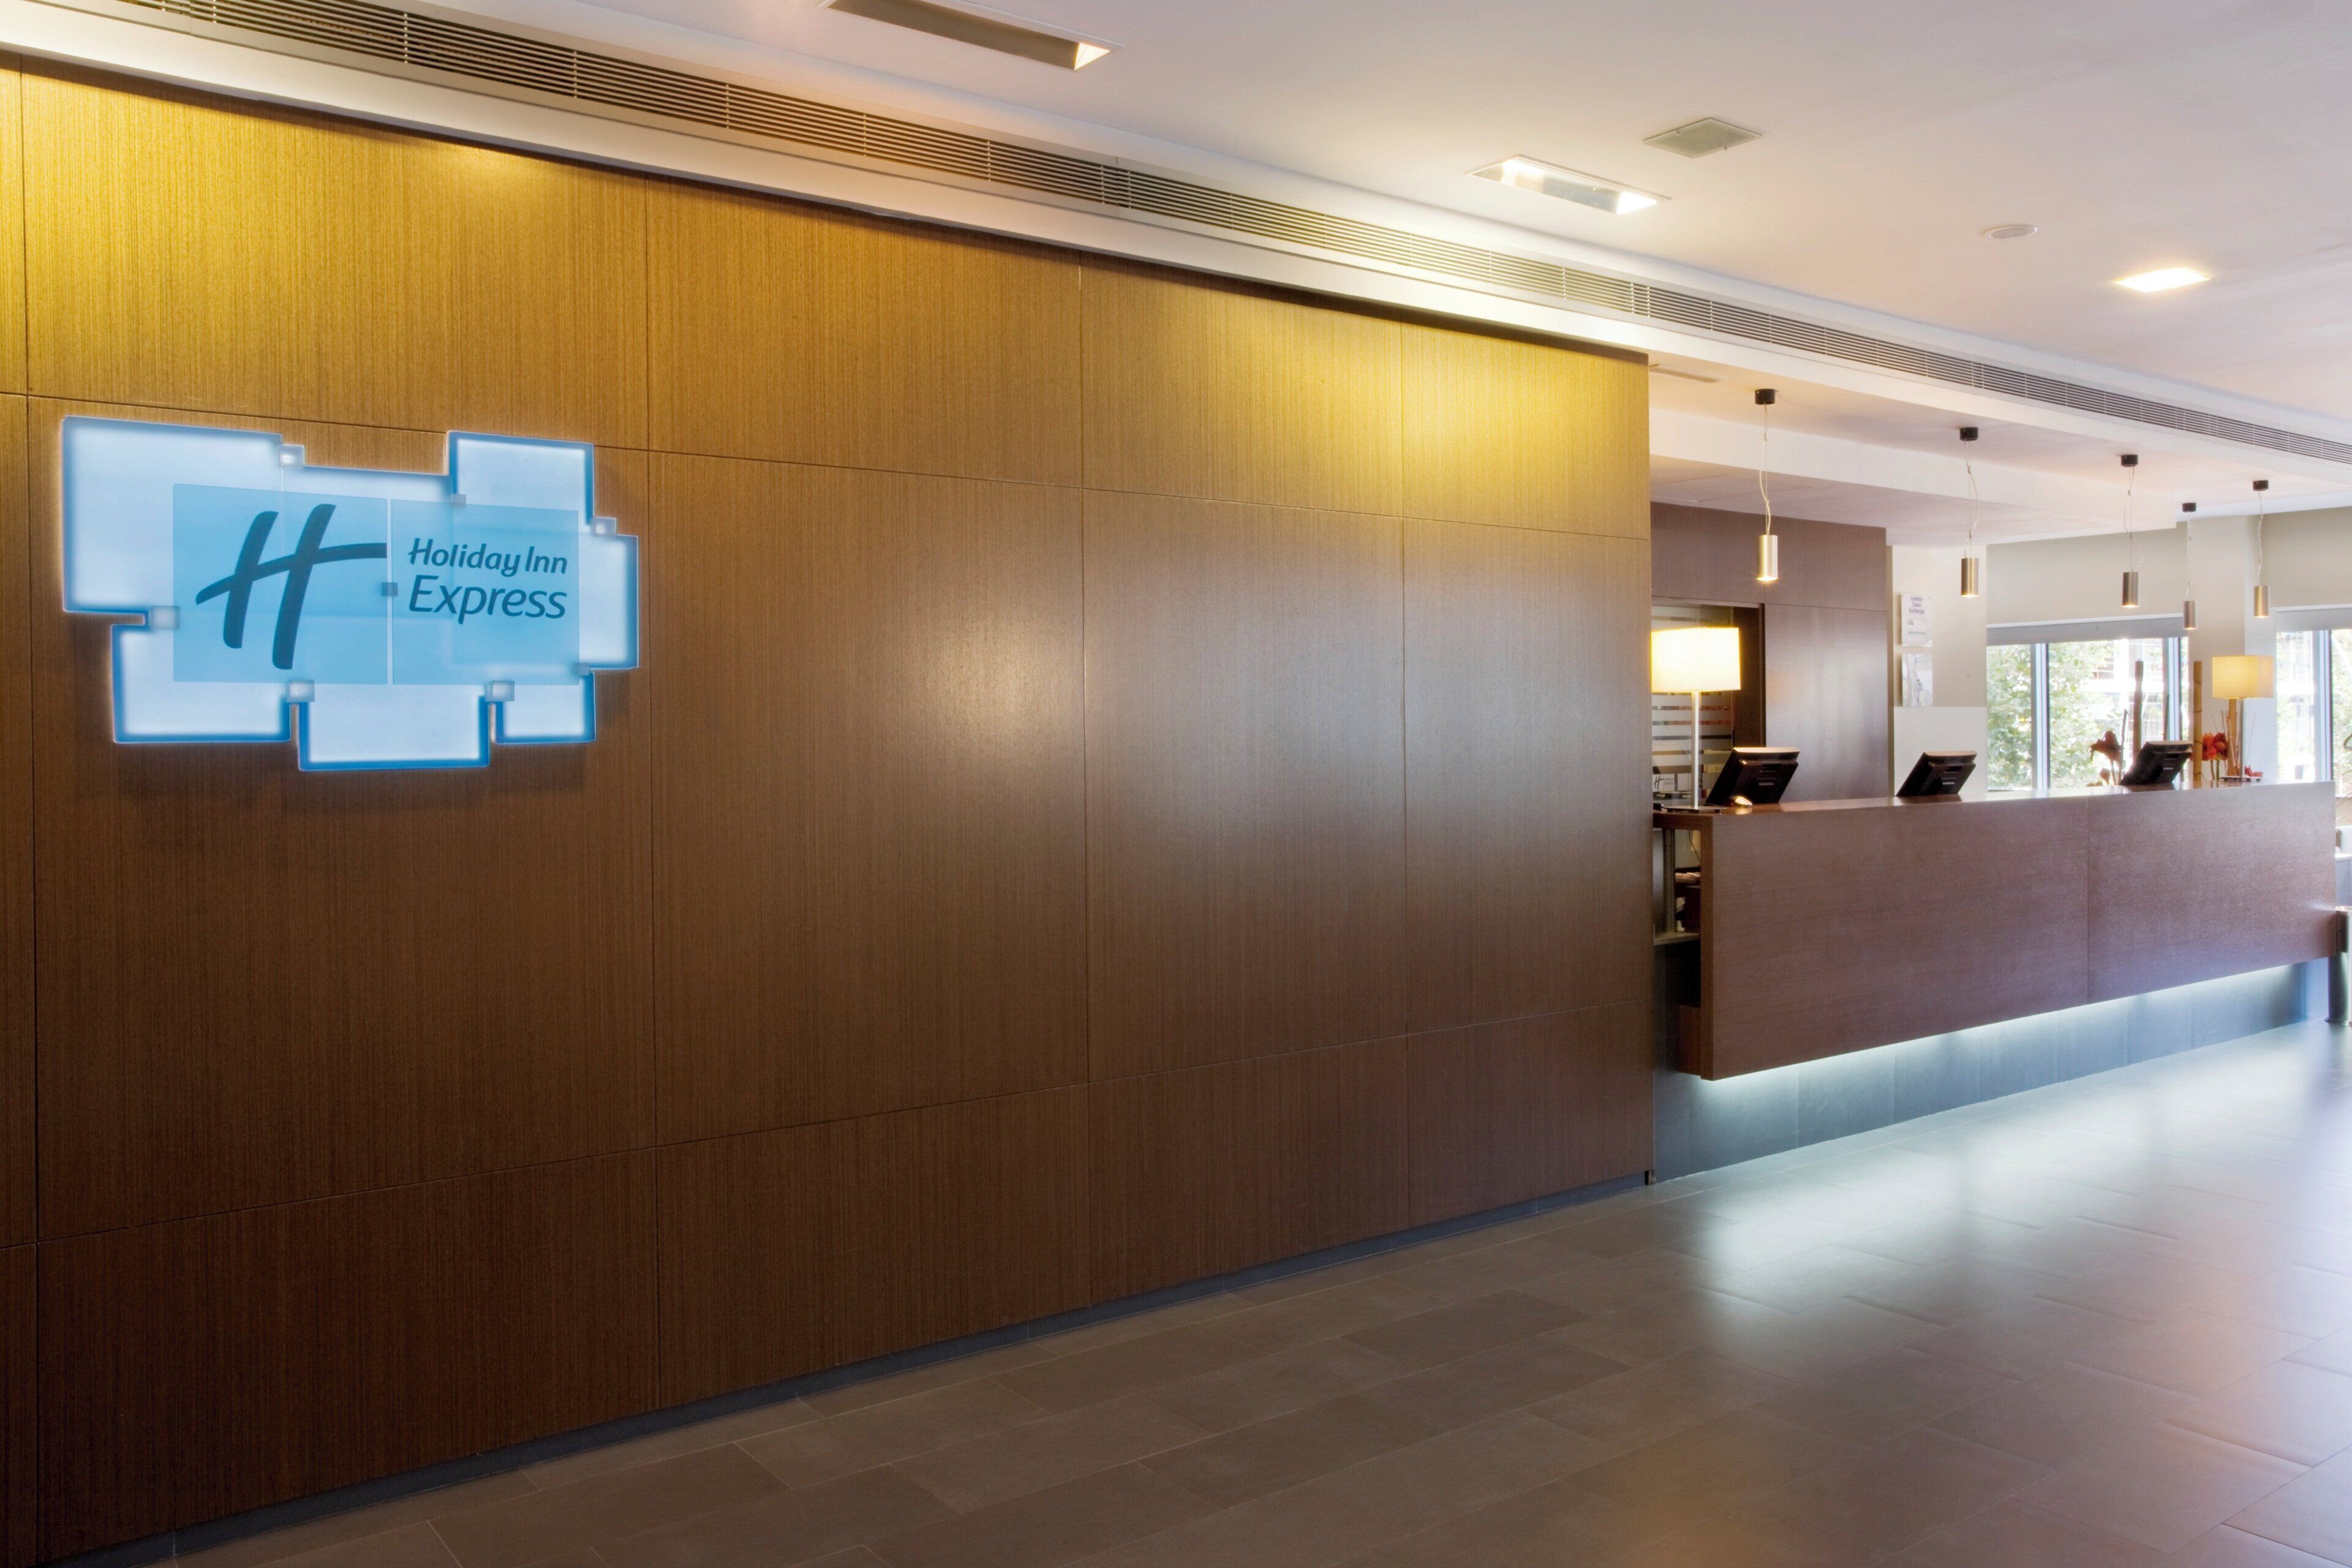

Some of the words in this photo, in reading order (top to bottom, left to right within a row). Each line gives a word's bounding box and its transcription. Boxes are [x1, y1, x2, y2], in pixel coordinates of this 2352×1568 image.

[408, 537, 521, 578] Holiday
[524, 546, 567, 575] Inn
[195, 503, 387, 670] H
[409, 574, 567, 625] Express
